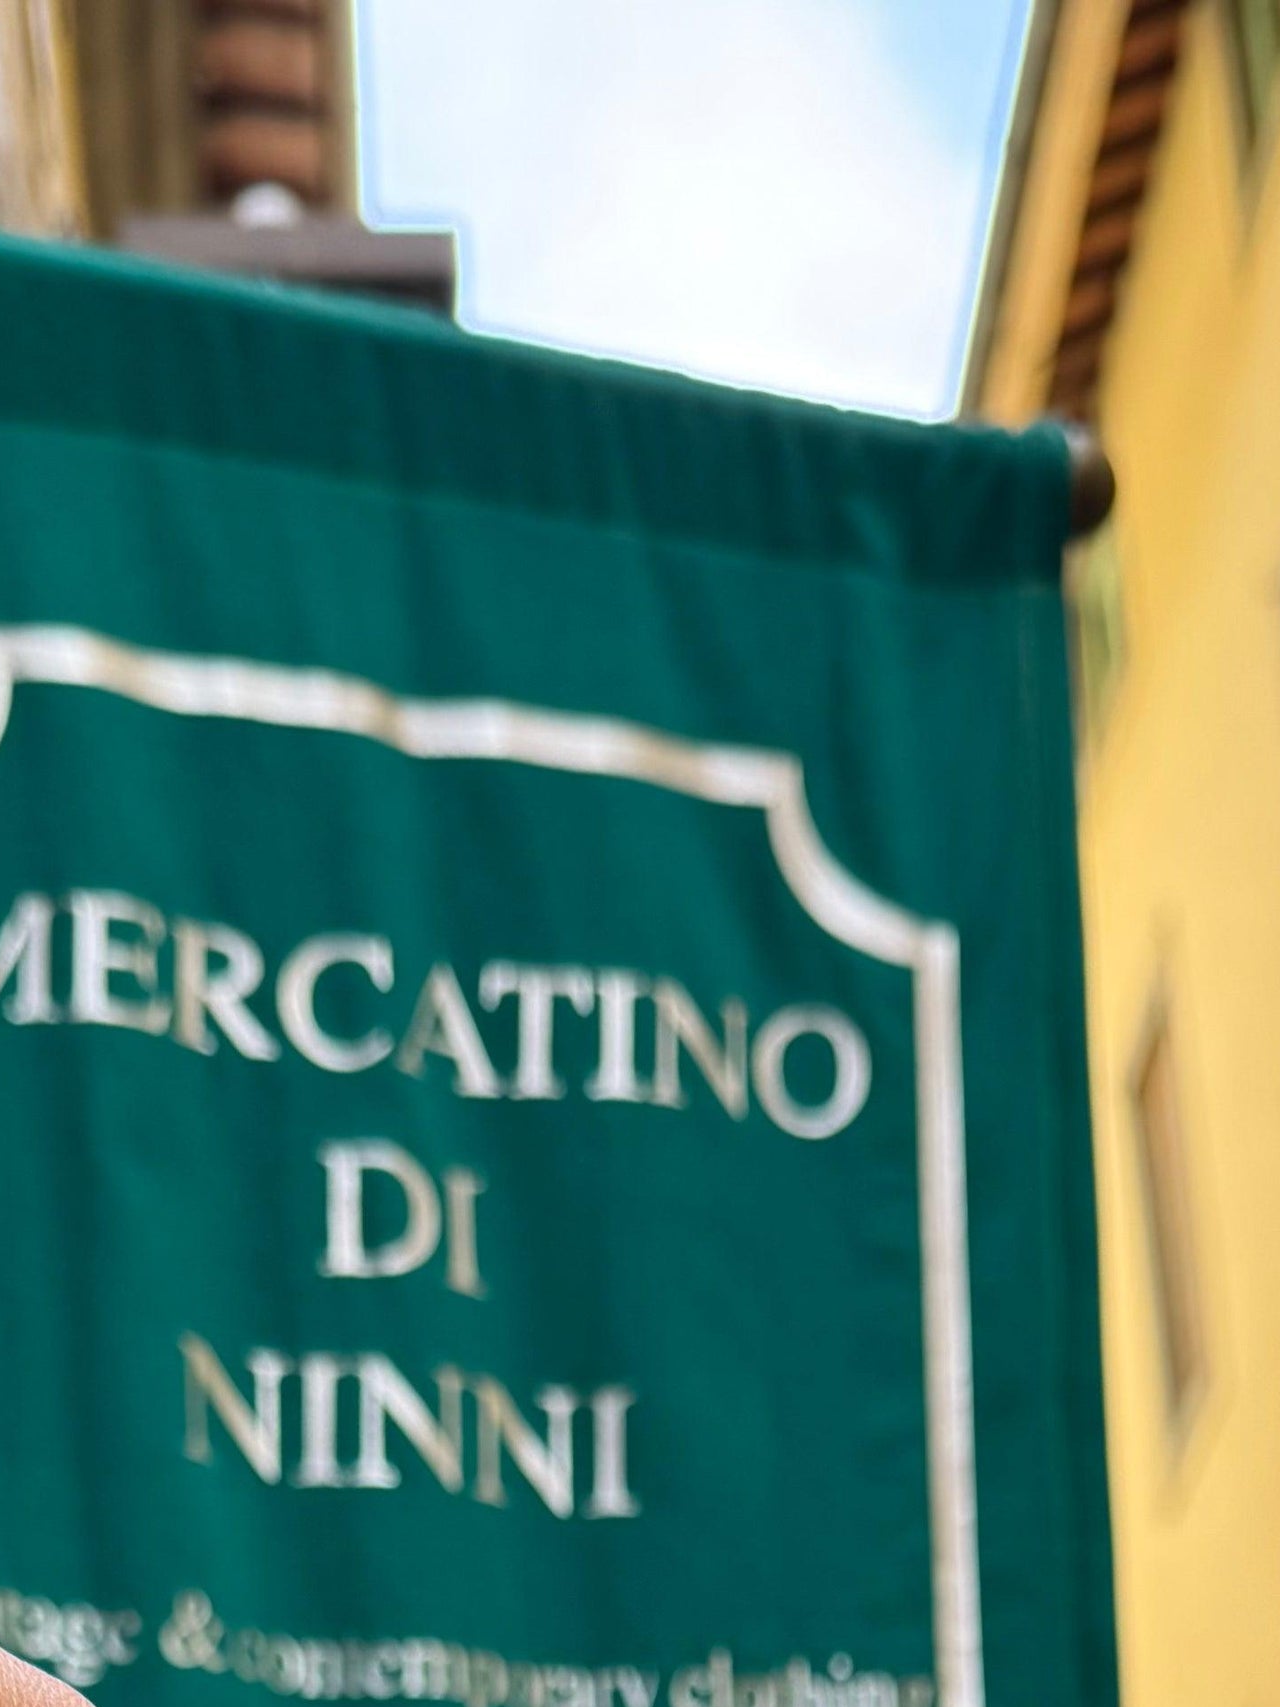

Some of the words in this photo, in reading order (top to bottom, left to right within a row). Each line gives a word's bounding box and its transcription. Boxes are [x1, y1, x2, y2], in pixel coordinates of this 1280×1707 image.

[317, 1136, 487, 1298] DI
[178, 1330, 641, 1520] NINNI
[158, 1588, 224, 1671] &
